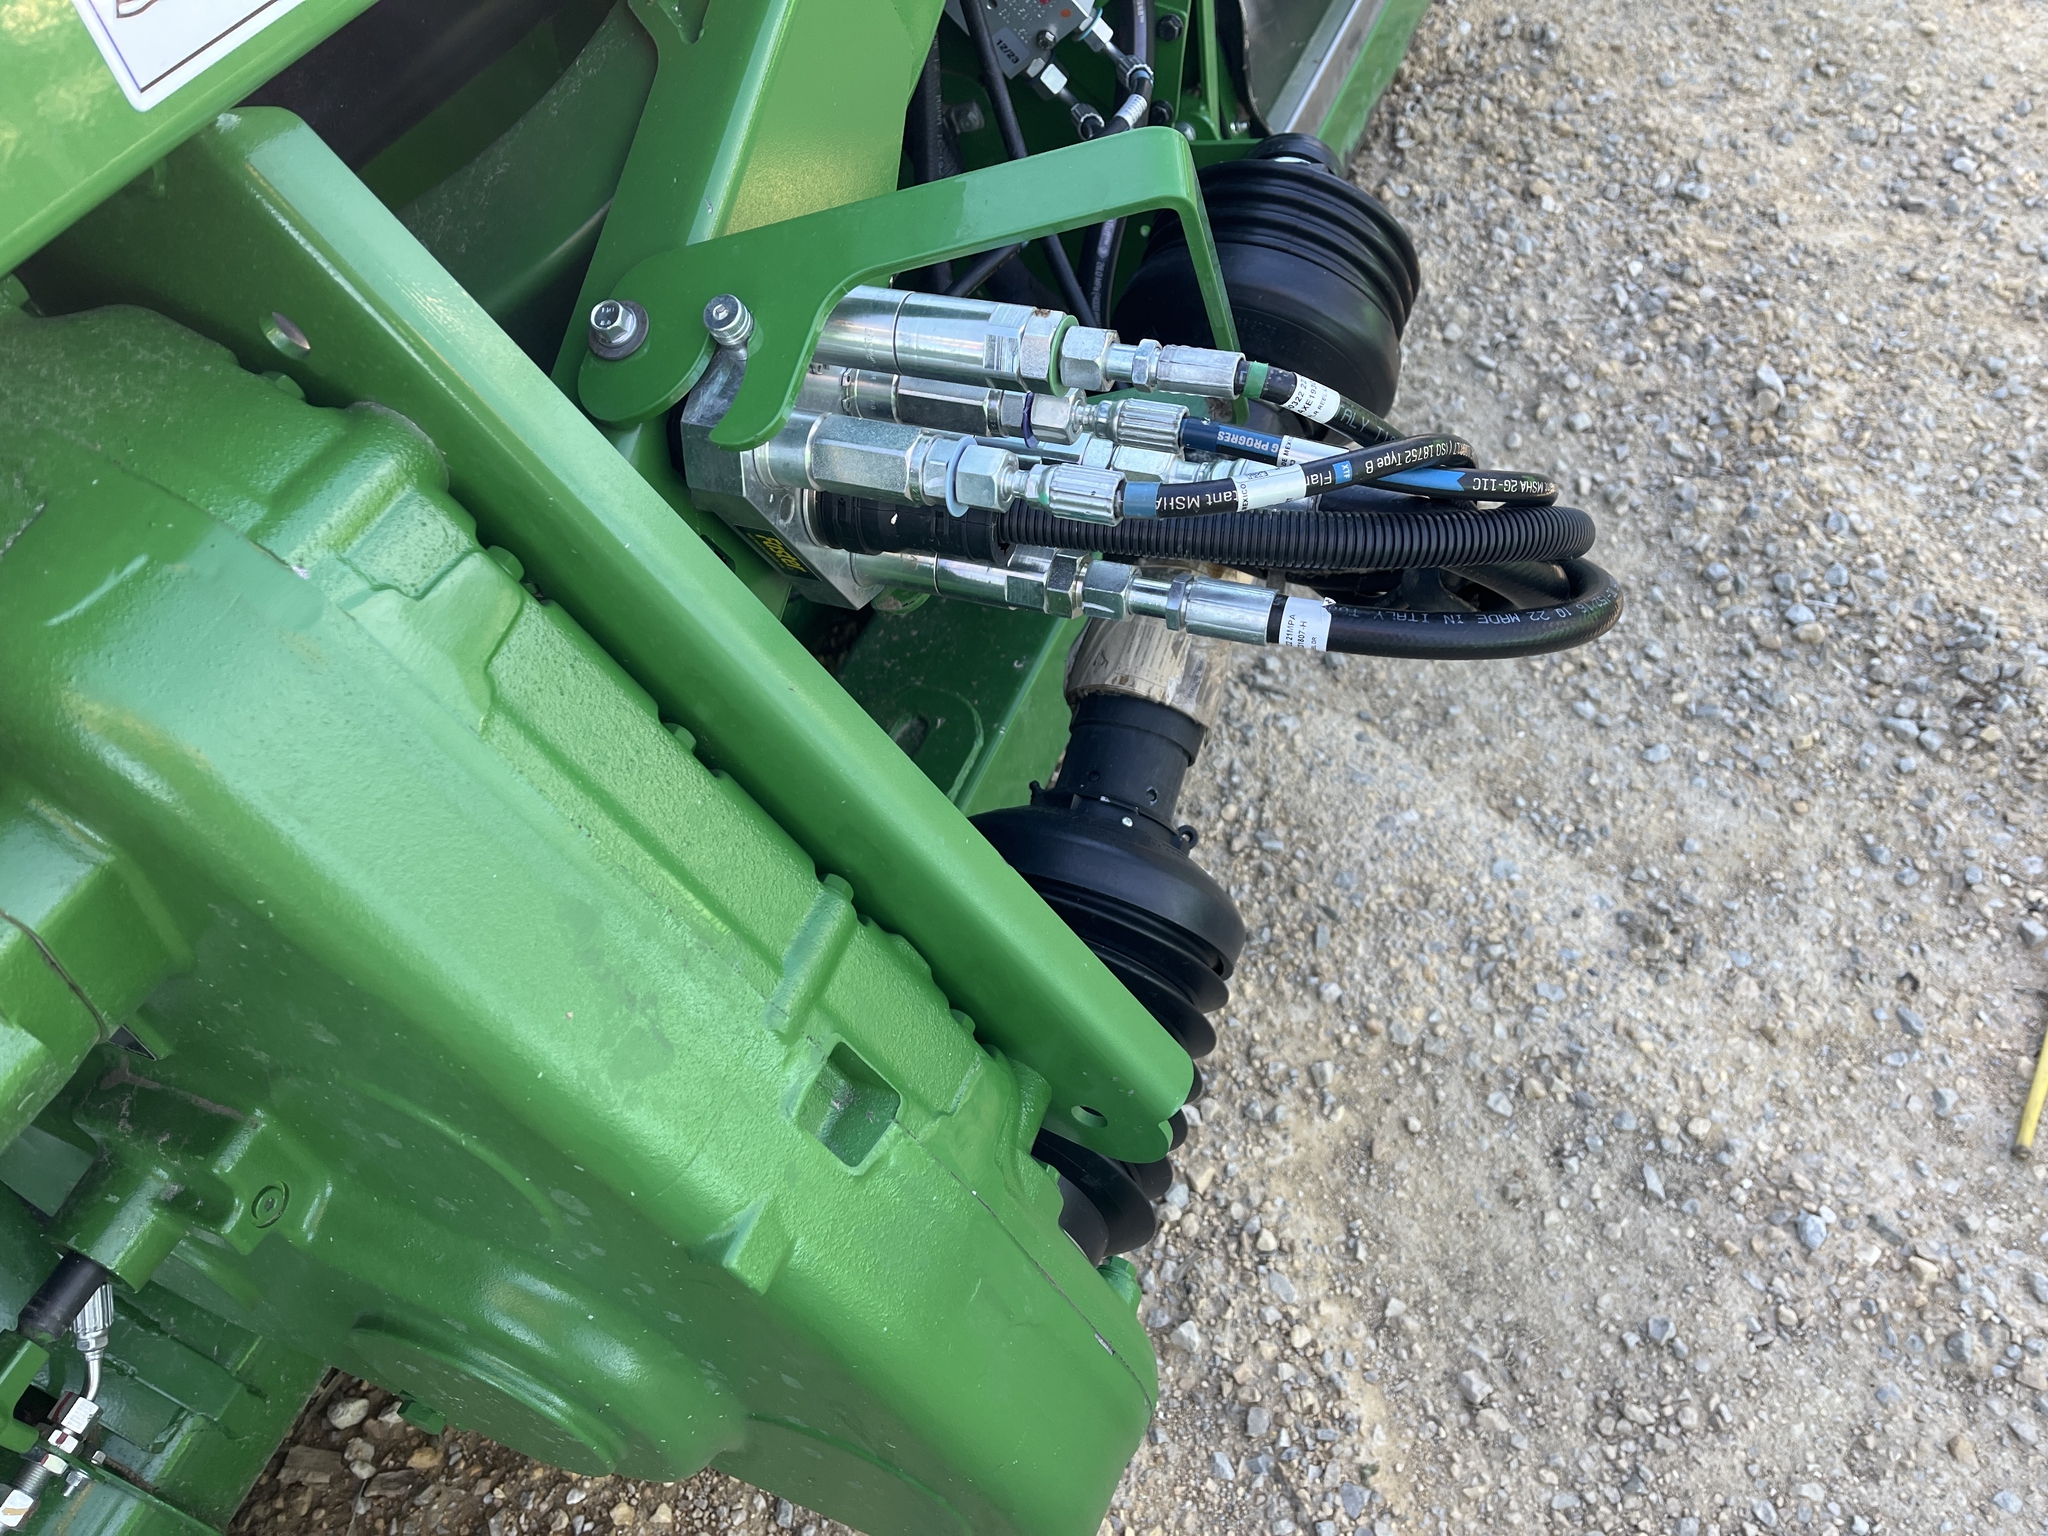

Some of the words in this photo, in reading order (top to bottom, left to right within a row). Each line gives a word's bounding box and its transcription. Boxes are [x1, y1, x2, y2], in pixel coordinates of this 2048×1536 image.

[1216, 430, 1270, 452] PROGRES
[1376, 450, 1403, 469] Type
[1404, 444, 1434, 464] 18752
[1364, 459, 1375, 474] B
[1472, 477, 1518, 493] 2G-11C
[1519, 480, 1544, 494] MSHA
[1155, 494, 1200, 511] MSHA
[1373, 610, 1430, 624] ITALY
[1443, 614, 1464, 625] IN
[1475, 612, 1521, 625] MADE
[1526, 610, 1550, 621] 22
